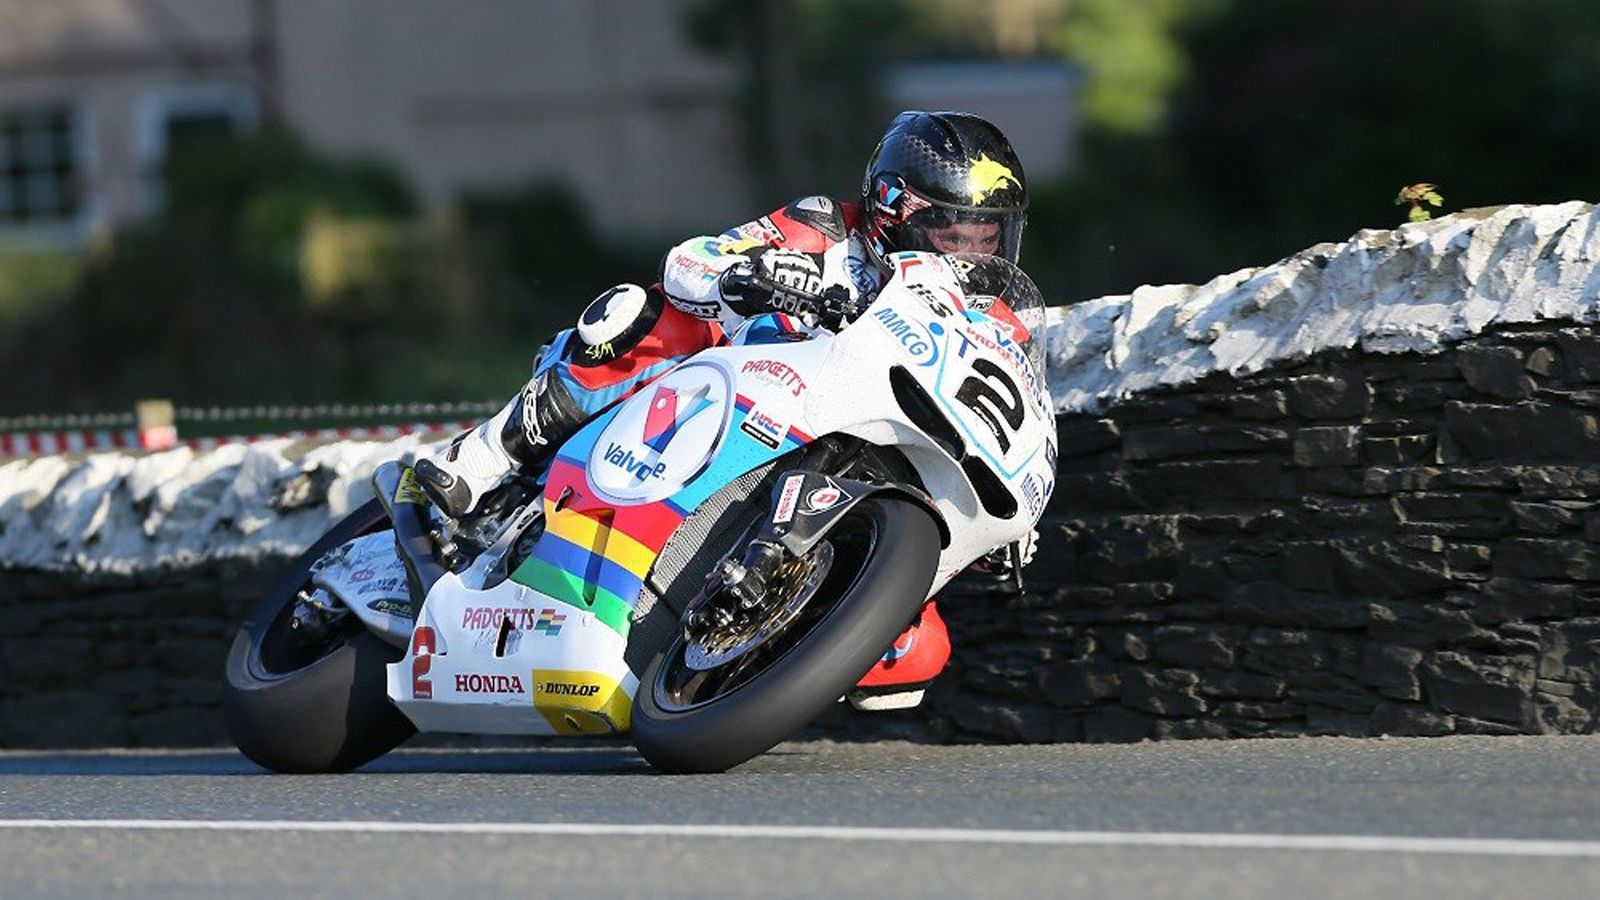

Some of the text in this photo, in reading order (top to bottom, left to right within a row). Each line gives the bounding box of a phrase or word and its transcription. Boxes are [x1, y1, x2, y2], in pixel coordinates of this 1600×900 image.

[873, 307, 929, 356] MMCG
[741, 359, 807, 397] PADGETT'S
[955, 357, 1024, 456] 2
[412, 626, 437, 699] 2
[455, 674, 525, 694] HONDA
[545, 682, 600, 697] DUNLOP
